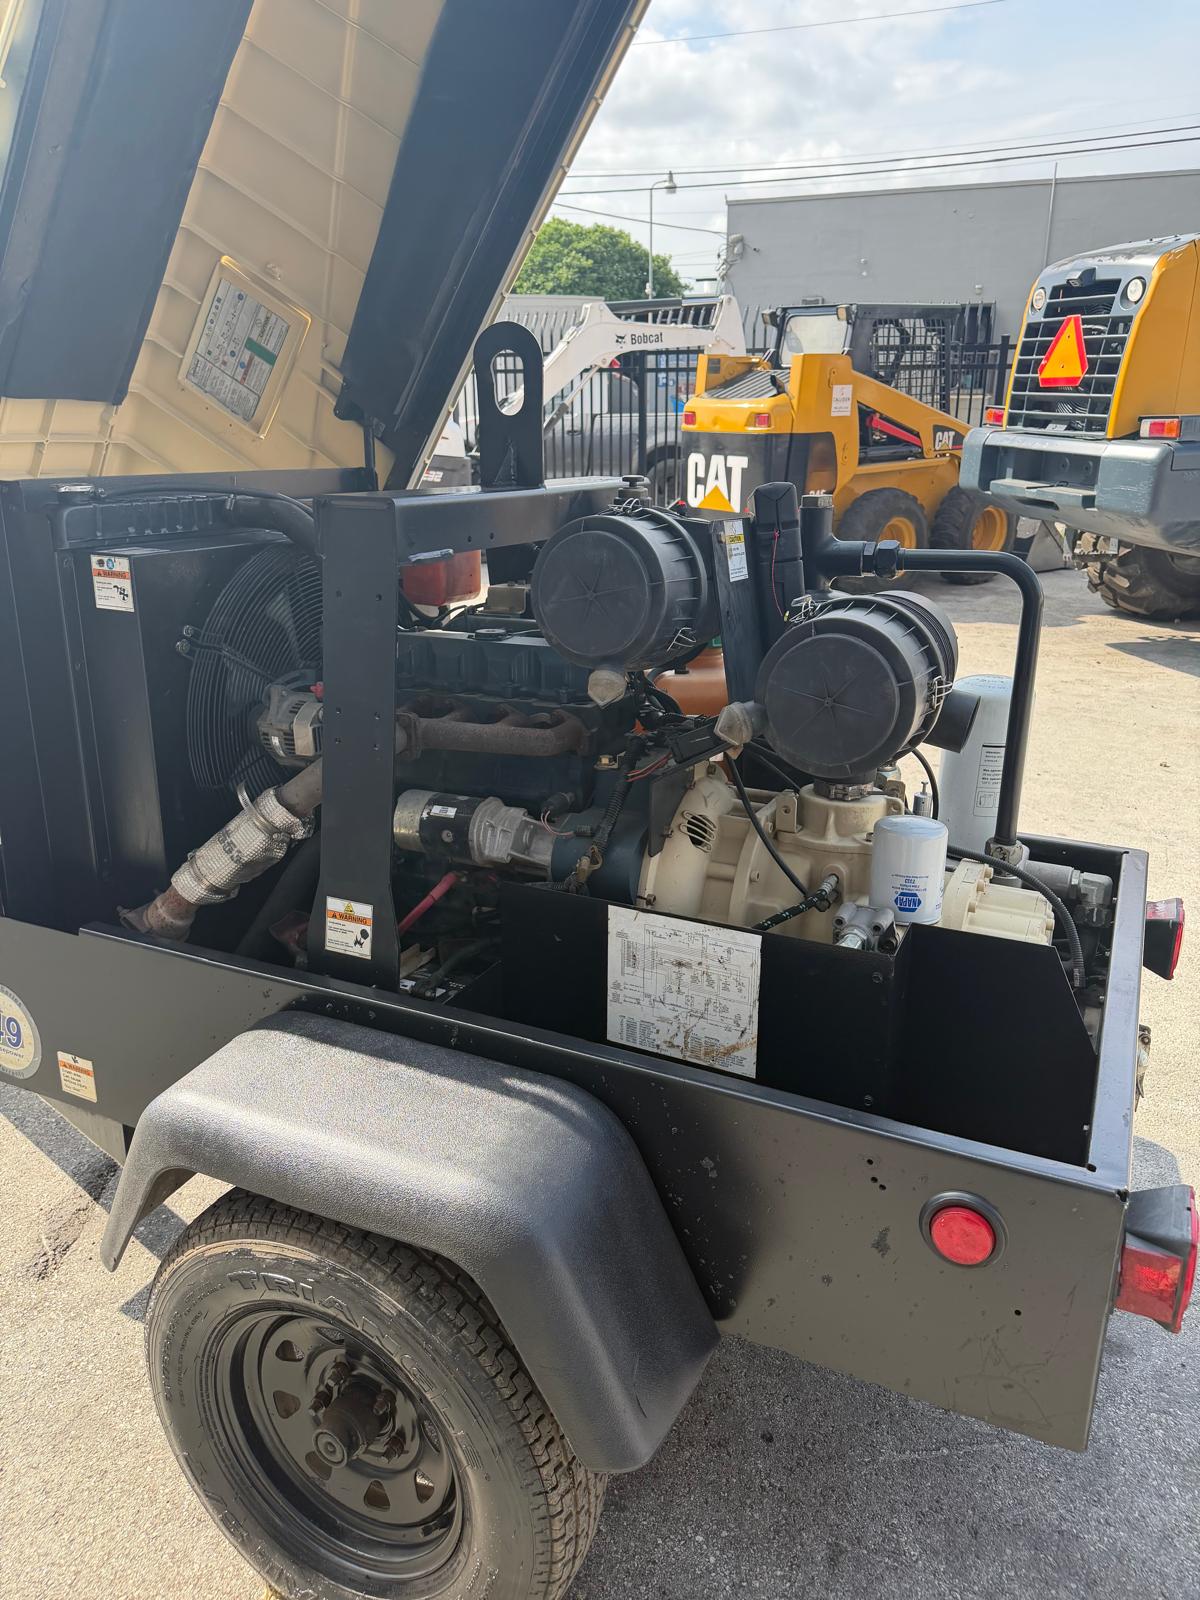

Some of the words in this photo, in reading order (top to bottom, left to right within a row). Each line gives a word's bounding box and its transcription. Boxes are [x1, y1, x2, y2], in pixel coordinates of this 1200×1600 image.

[630, 332, 663, 345] Bobcat
[935, 431, 955, 451] CAT
[687, 452, 749, 513] CAT
[102, 570, 127, 579] WARNING
[898, 896, 918, 908] NAPA
[339, 912, 367, 924] WARNING
